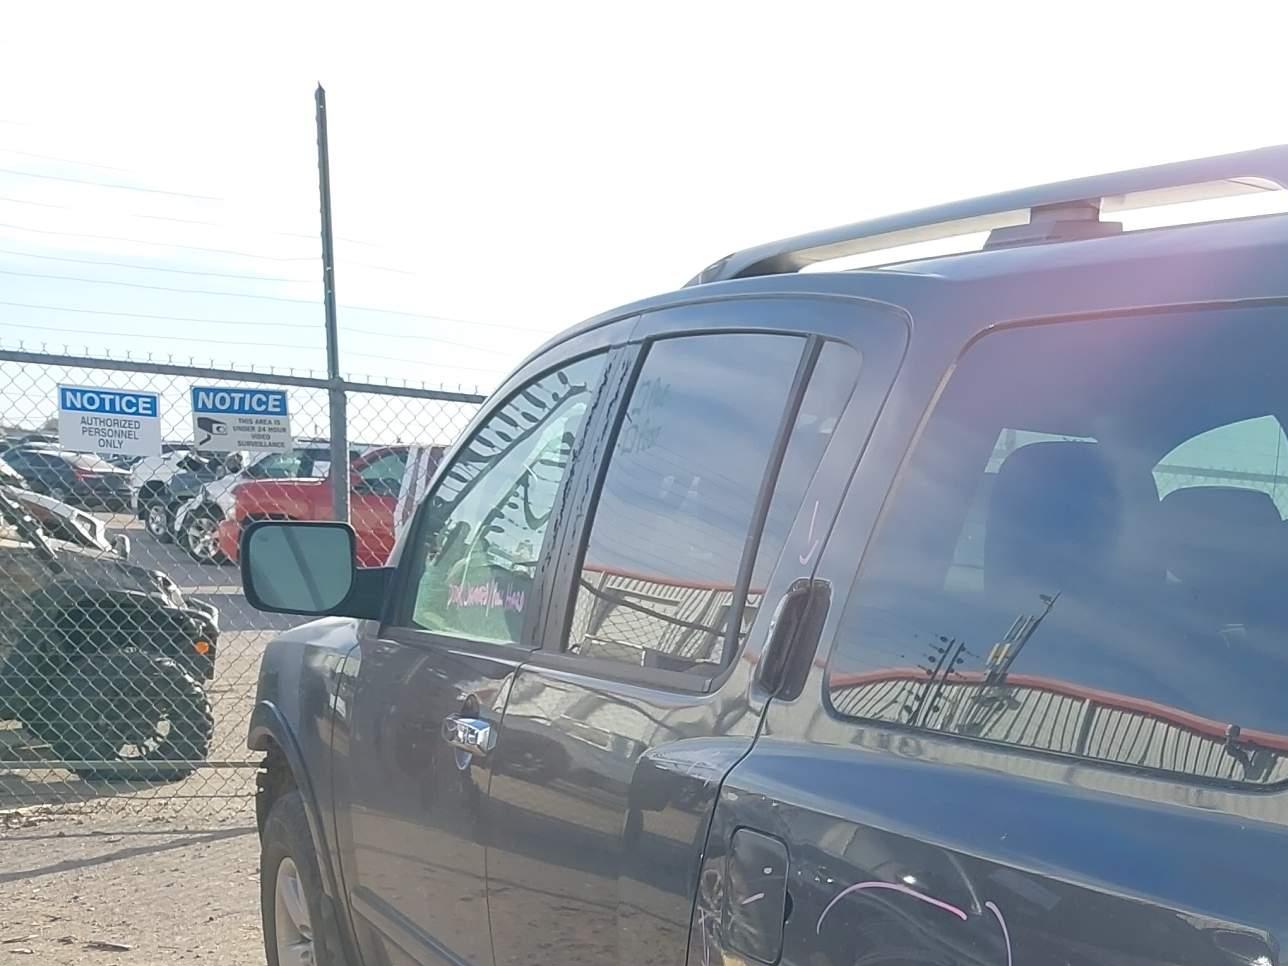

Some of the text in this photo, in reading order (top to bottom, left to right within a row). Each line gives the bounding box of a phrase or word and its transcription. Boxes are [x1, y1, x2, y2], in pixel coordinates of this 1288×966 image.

[65, 391, 153, 414] NOTICE
[197, 391, 282, 412] NOTICE
[80, 416, 141, 429] AUTHORIZED
[81, 426, 139, 440] PERSONNEL
[98, 439, 123, 449] ONLY
